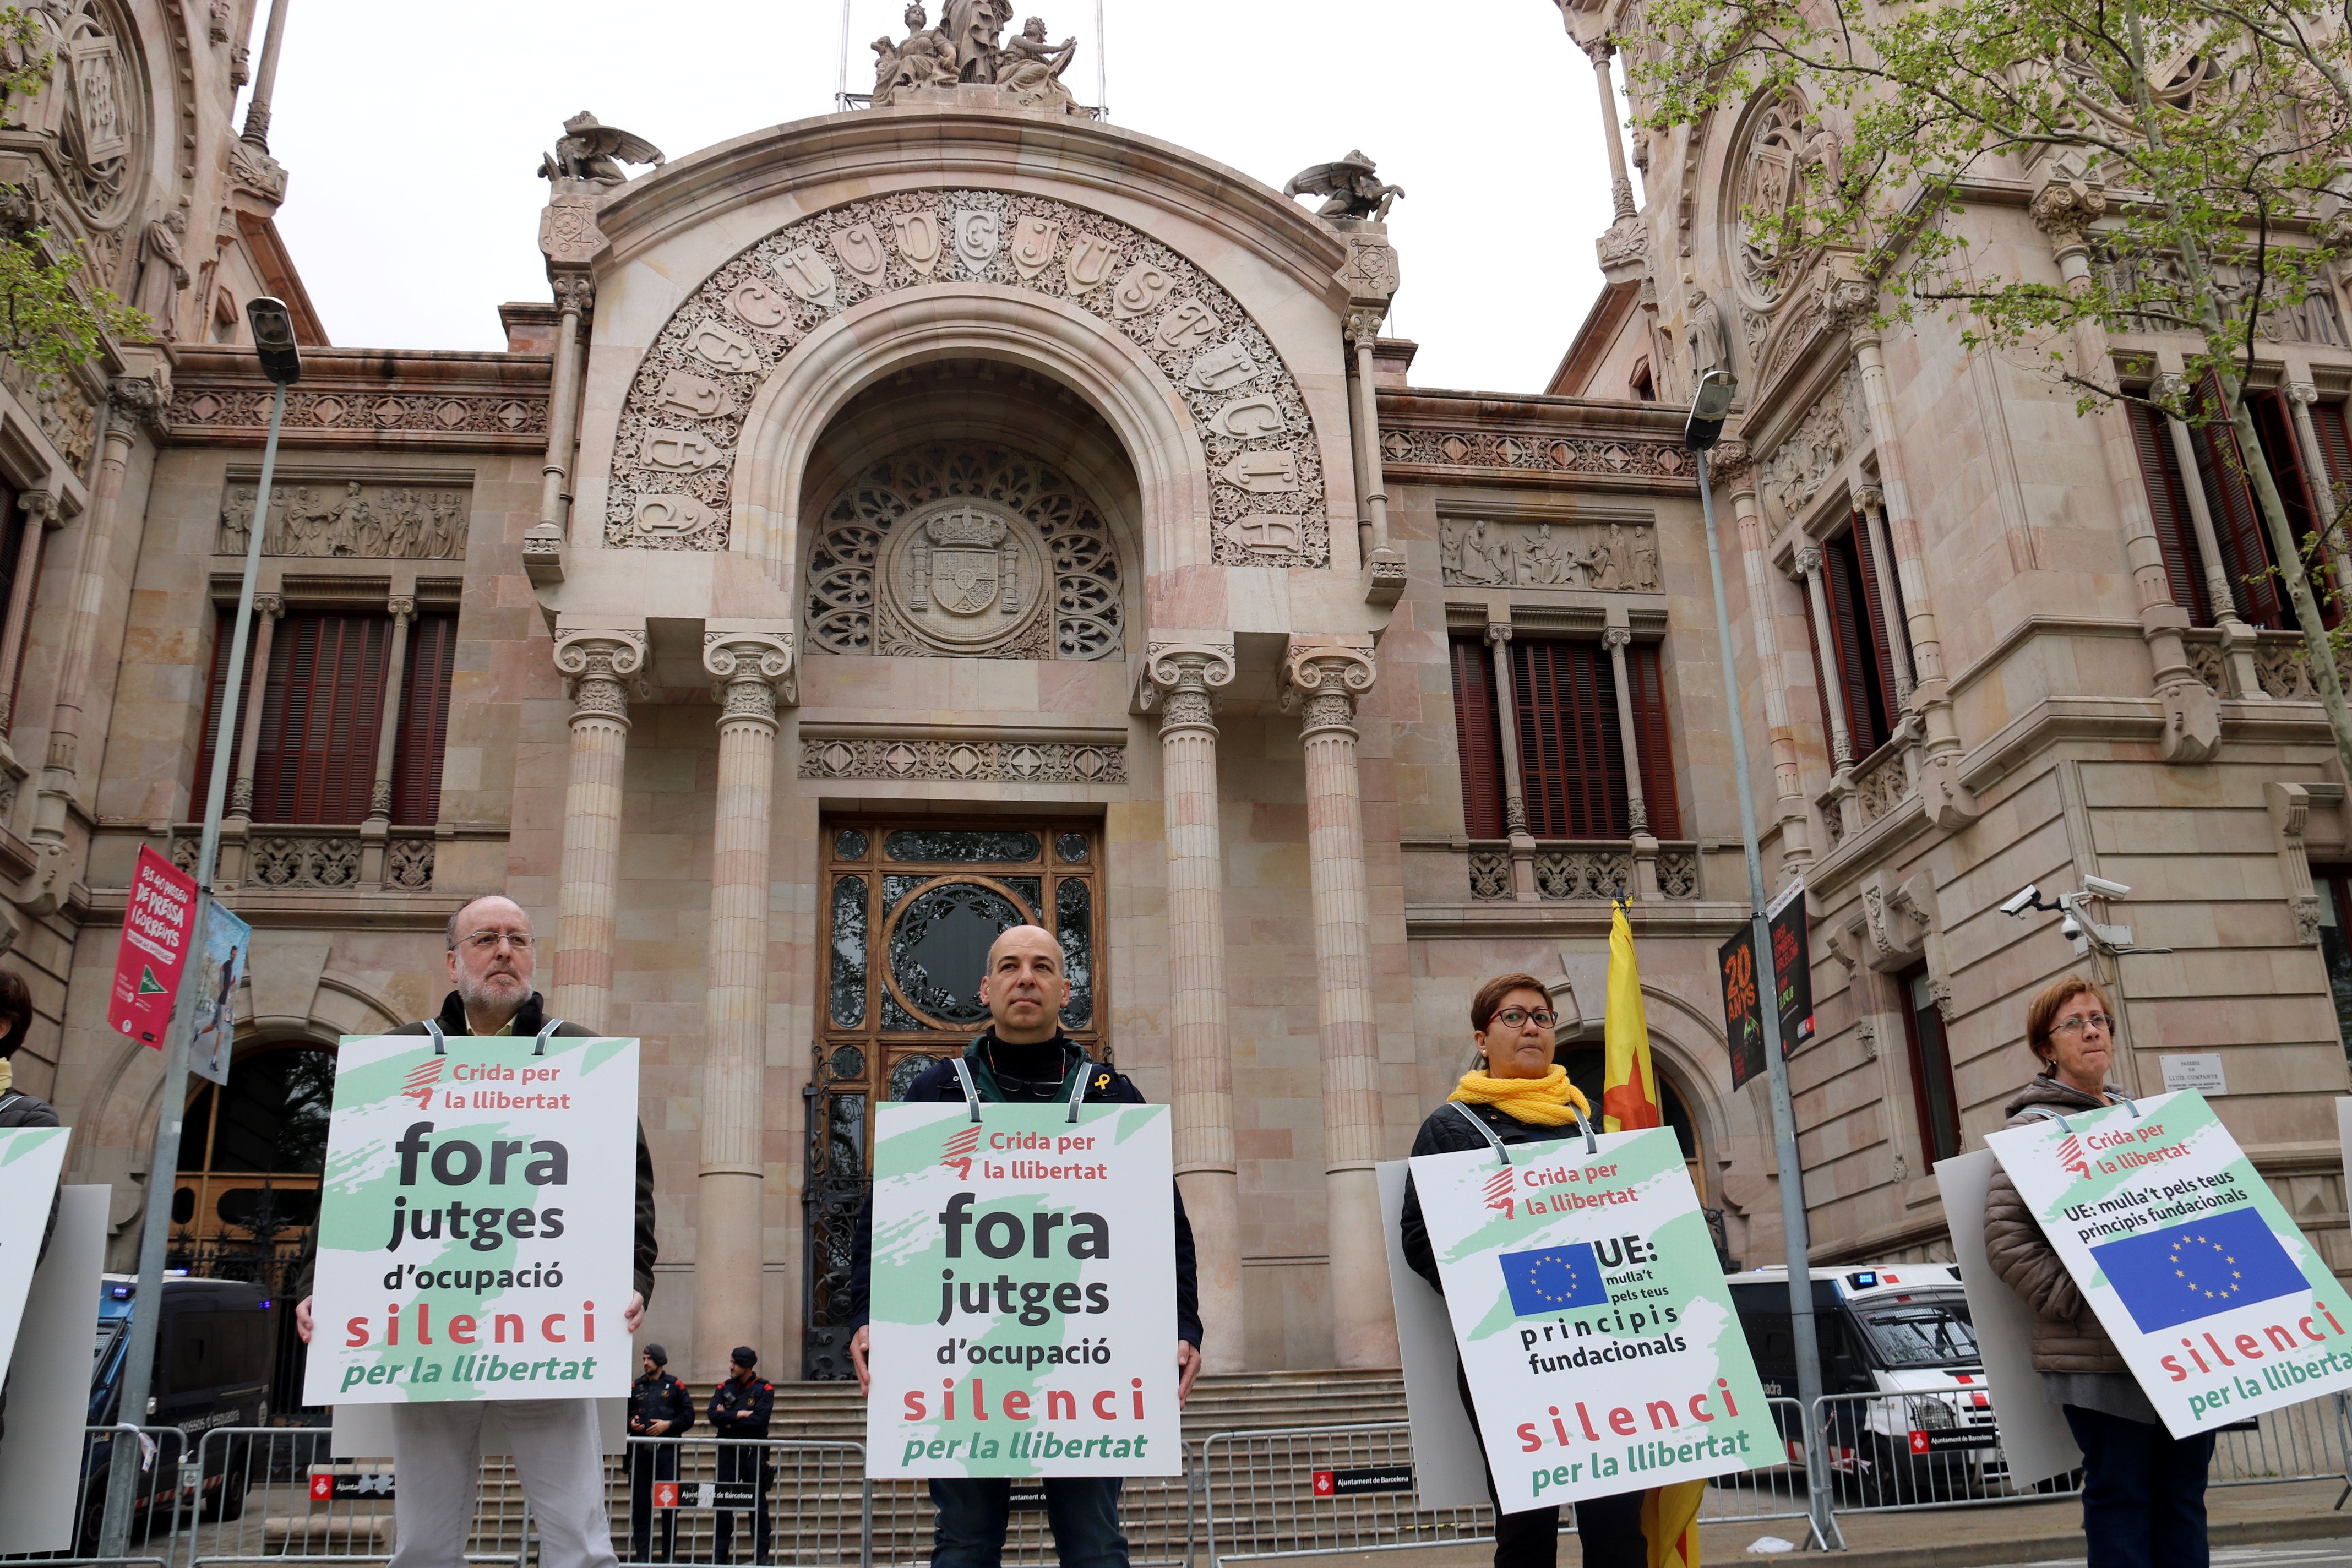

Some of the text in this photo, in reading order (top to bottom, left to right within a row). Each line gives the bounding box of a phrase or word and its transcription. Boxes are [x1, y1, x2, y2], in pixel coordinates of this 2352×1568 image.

[141, 865, 154, 881] ELS
[153, 875, 165, 890] 40
[135, 883, 184, 928] DE PRESSA
[135, 908, 179, 947] CORRENTS
[1724, 944, 1751, 1001] 20
[1728, 983, 1755, 1023] ANYS
[453, 1064, 560, 1085] Crida per
[445, 1091, 571, 1109] la llibertat
[395, 1121, 568, 1186] fora
[989, 1131, 1095, 1155] Crida per
[2087, 1123, 2165, 1152] Crida per
[984, 1160, 1107, 1180] la llibertat
[1523, 1162, 1619, 1188] Crida per
[2097, 1142, 2191, 1174] la llibertat
[1525, 1185, 1639, 1216] la llibertat
[2064, 1171, 2235, 1222] UE: mulla't pels teus
[2078, 1188, 2248, 1244] principis fundacionals
[386, 1196, 564, 1252] jutges
[939, 1193, 1110, 1259] fora
[1593, 1235, 1658, 1267] UE:
[384, 1261, 563, 1294] d'ocupació
[1606, 1268, 1654, 1286] mulla't
[1611, 1285, 1669, 1306] pels teus
[937, 1269, 1109, 1326] jutges
[346, 1300, 595, 1347] silenci
[1521, 1304, 1678, 1350] principis
[2161, 1302, 2345, 1381] silenci
[937, 1338, 1111, 1371] d'ocupació
[1528, 1333, 1686, 1375] fundacionals
[340, 1355, 597, 1393] per la llibertat
[2188, 1348, 2352, 1420] per la lliberta
[903, 1378, 1145, 1421] silenci
[1516, 1378, 1739, 1453] silenci
[902, 1431, 1148, 1466] per la llibertat
[1532, 1429, 1750, 1496] per la llibertat
[1338, 1478, 1371, 1487] Ajuntament
[1381, 1475, 1409, 1483] Barcelona
